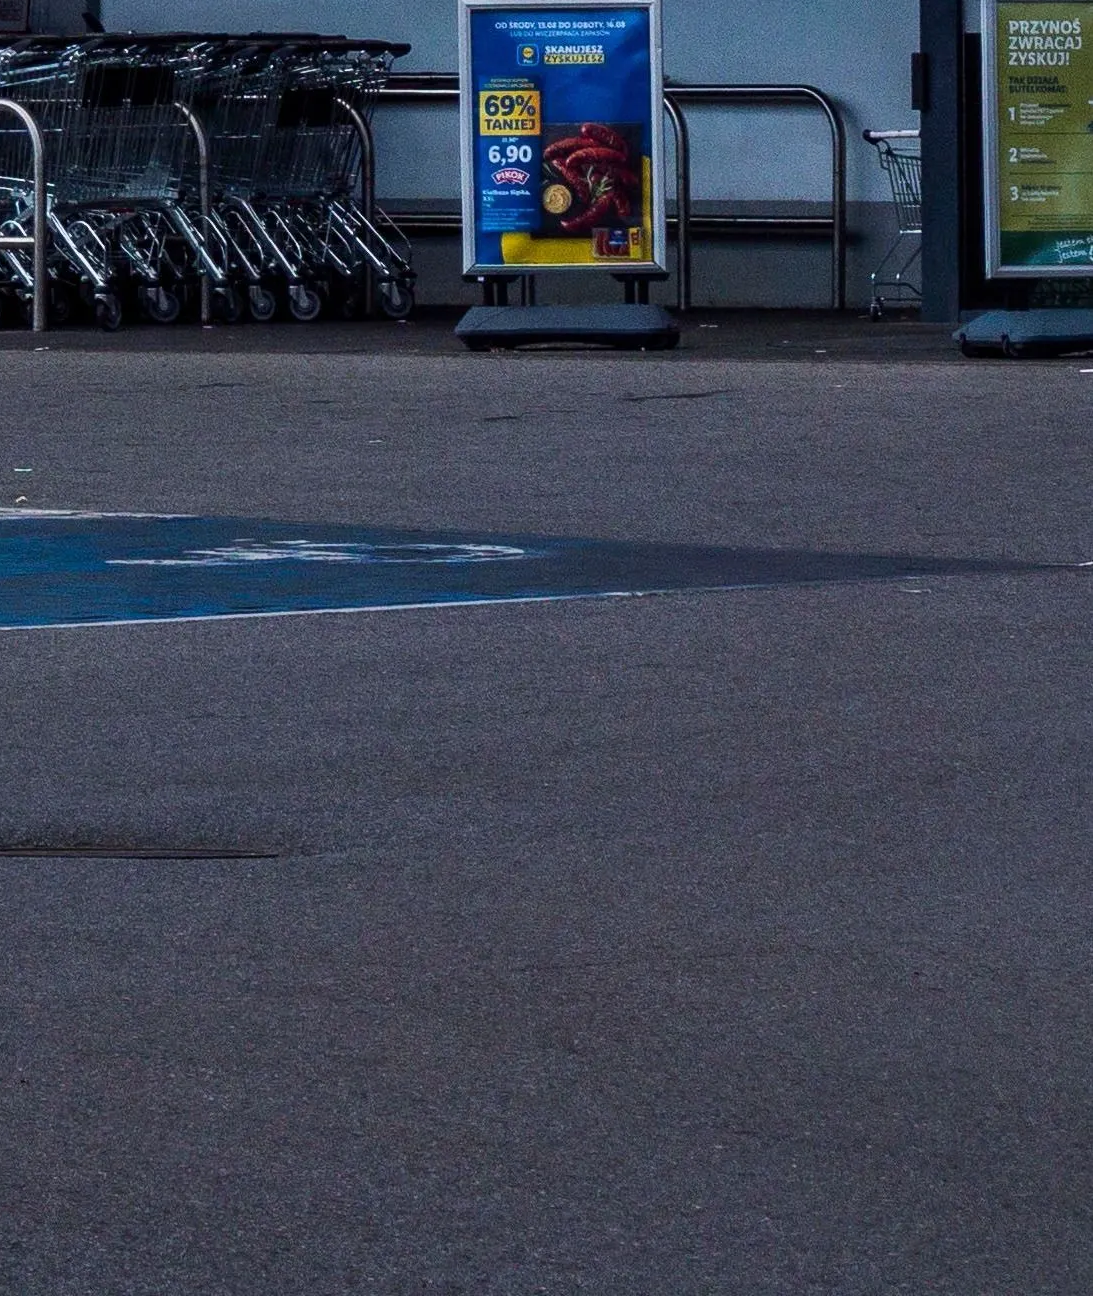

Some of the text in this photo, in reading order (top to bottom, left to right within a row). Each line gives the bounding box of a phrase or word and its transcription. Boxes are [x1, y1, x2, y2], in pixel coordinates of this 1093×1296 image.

[558, 21, 571, 29] DO
[1009, 18, 1081, 34] PRZYNOŚ
[545, 45, 603, 54] SKANUJESZ
[1009, 36, 1082, 50] ZWRACAJ
[545, 54, 603, 63] ZYSKUJESZ
[1009, 52, 1070, 66] ZYSKUJ!
[484, 95, 537, 117] 69%
[1008, 107, 1016, 121] 1
[484, 119, 536, 130] TANIEJ
[488, 145, 533, 166] 6,90
[1009, 147, 1019, 163] 2
[1009, 186, 1019, 201] 3
